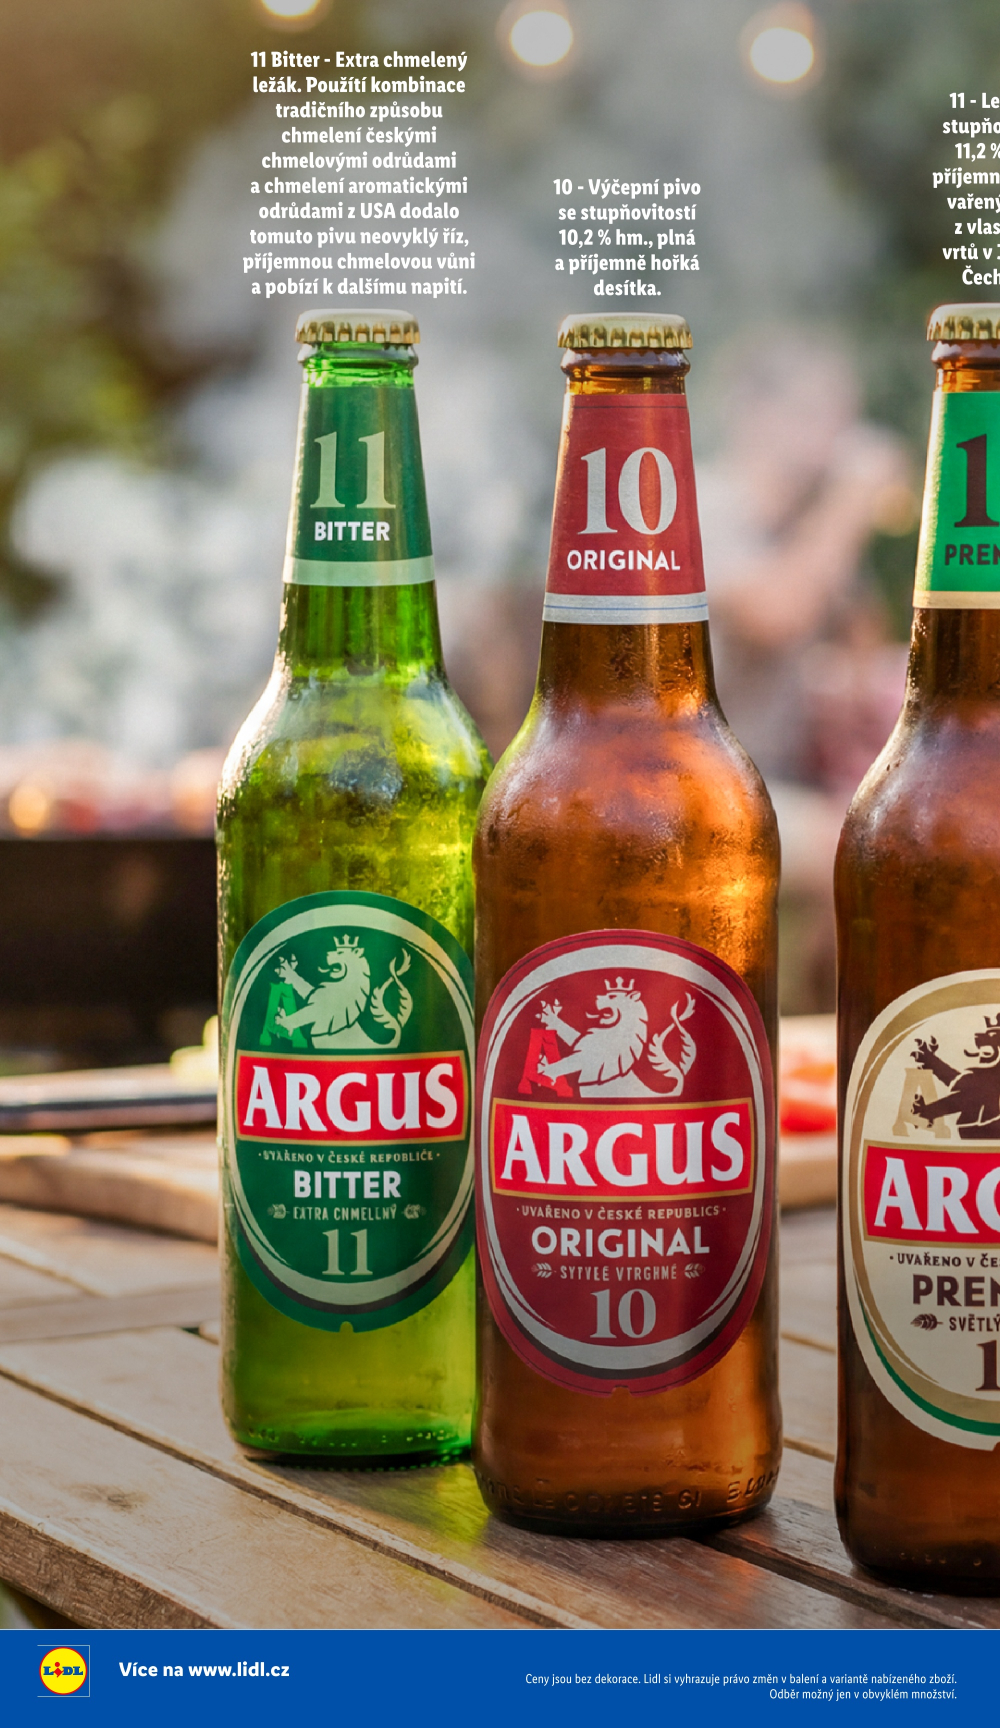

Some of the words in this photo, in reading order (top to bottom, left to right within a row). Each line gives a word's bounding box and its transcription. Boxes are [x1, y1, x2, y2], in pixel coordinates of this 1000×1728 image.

[310, 430, 396, 509] 11
[577, 446, 678, 535] 10
[314, 521, 391, 541] BITTER
[567, 550, 681, 571] ORIGINAL
[243, 1063, 458, 1133] ARGUS
[500, 1111, 744, 1187] ARGUS
[294, 1169, 402, 1199] BITTER
[585, 1209, 593, 1220] V
[321, 1228, 373, 1277] 11
[531, 1226, 710, 1258] ORIGINAL
[897, 1252, 962, 1267] UVAŘENO
[965, 1257, 976, 1268] V
[980, 1252, 1000, 1268] ČE
[590, 1288, 657, 1339] 10
